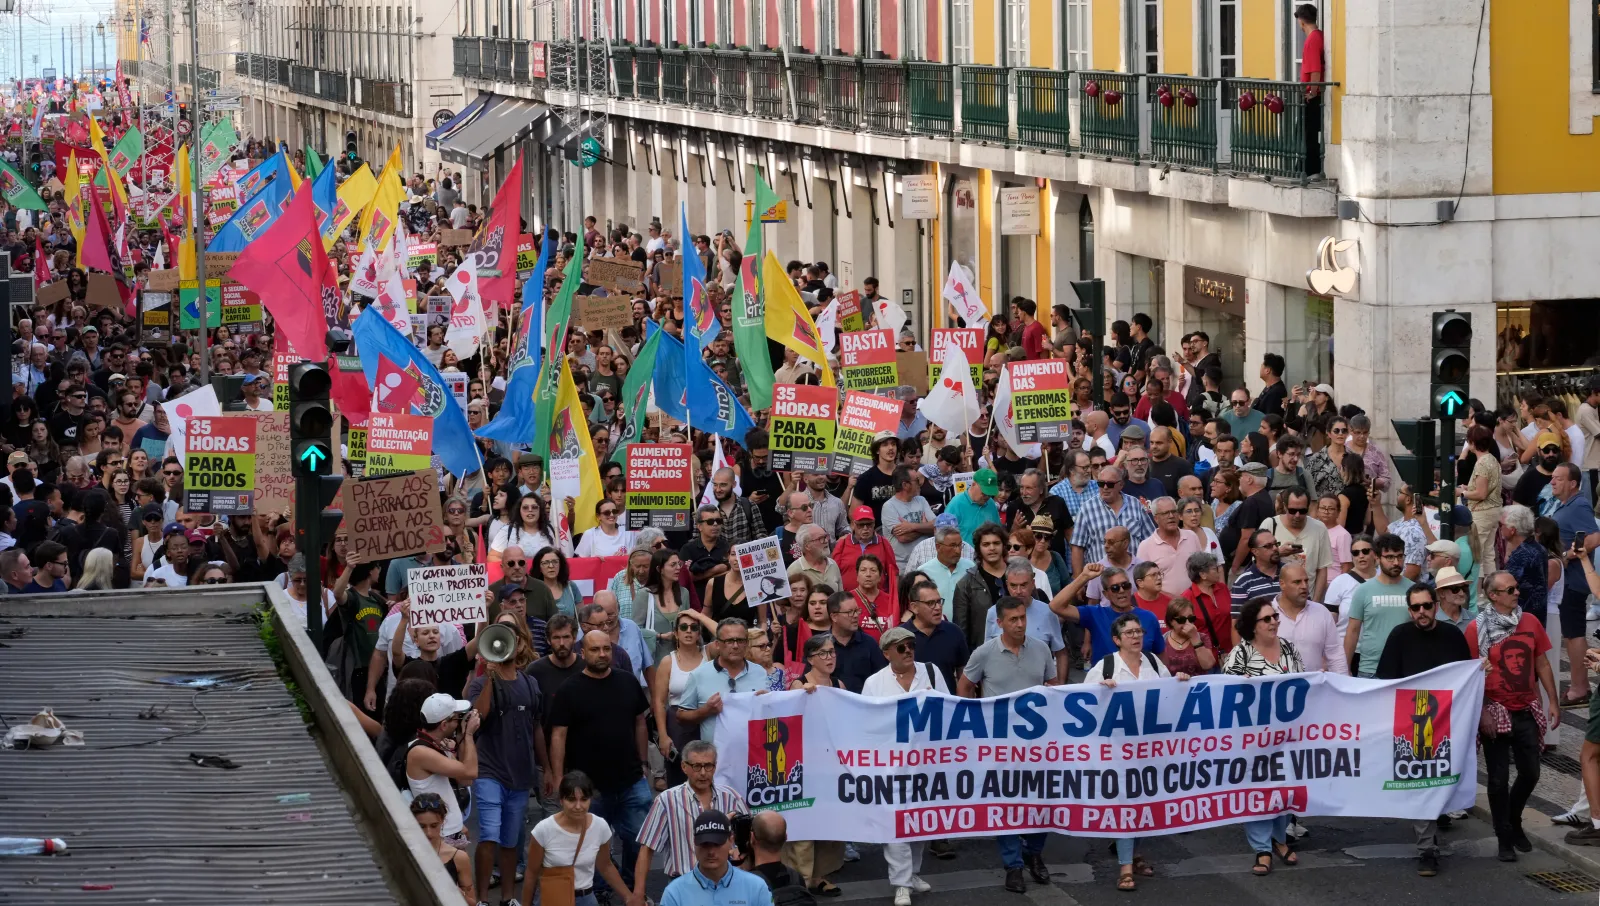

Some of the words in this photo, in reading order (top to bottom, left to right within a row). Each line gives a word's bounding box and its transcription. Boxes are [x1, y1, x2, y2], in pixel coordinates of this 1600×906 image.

[62, 157, 102, 169] JVENS
[212, 187, 234, 200] SMN
[843, 333, 887, 351] BASTA
[934, 331, 977, 349] BASTA
[844, 352, 858, 365] DE
[846, 366, 892, 378] EMPOBRECER
[1012, 362, 1064, 377] AUMENTO
[847, 380, 852, 388] A
[854, 375, 895, 388] TRABALHAR
[1013, 378, 1035, 390] DAS
[777, 387, 796, 400] 35
[1015, 392, 1066, 407] REFORMAS
[775, 402, 830, 418] HORAS
[848, 394, 853, 403] A
[855, 396, 899, 414] SEGURANÇA
[846, 406, 871, 418] SOCIAL
[1017, 409, 1022, 420] E
[1024, 405, 1066, 420] PENSÕES
[191, 420, 212, 434] 35
[373, 417, 386, 427] SIM
[388, 416, 394, 427] À
[774, 420, 817, 435] PARA
[843, 413, 849, 425] É
[850, 418, 876, 430] NOSSA!
[372, 430, 428, 442] CONTRATAÇÃO
[774, 435, 826, 450] TODOS
[840, 428, 858, 442] NÃO
[859, 432, 865, 443] É
[189, 437, 250, 451] HORAS
[371, 439, 412, 450] COLECTIVA
[631, 448, 682, 457] AUMENTO
[189, 457, 236, 472] PARA
[370, 455, 387, 466] NÃO
[388, 456, 394, 466] À
[631, 459, 665, 468] GERAL
[666, 459, 687, 468] DOS
[189, 472, 246, 487] TODOS
[630, 469, 682, 478] SALÁRIOS
[352, 481, 391, 501] PAZ
[401, 475, 432, 493] AOS
[630, 481, 650, 490] 15%
[358, 492, 428, 516] BARRACOS
[629, 494, 664, 506] MÍNIMO
[665, 496, 686, 505] 150€
[354, 514, 398, 532] GUERRA
[406, 511, 433, 527] AOS
[738, 545, 760, 555] SALÁRIO
[761, 540, 777, 549] IGUAL
[410, 571, 420, 580] UM
[422, 568, 456, 580] GOVERNO
[458, 568, 468, 576] QUE
[469, 564, 484, 575] NÃO
[755, 561, 777, 571] TRABALHO
[409, 582, 444, 594] TOLERA
[446, 578, 485, 590] PROTESTO
[417, 592, 434, 605] NÃO
[438, 593, 474, 602] TOLERA
[411, 606, 484, 626] DEMOCRACIA
[896, 692, 1048, 743] MAIS
[1062, 678, 1310, 737] SALÁRIO
[837, 745, 967, 766] MELHORES
[978, 741, 1090, 762] PENSÕES
[1101, 744, 1112, 761] E
[1122, 735, 1232, 760] SERVIÇOS
[1242, 723, 1361, 750] PÚBLICOS!
[838, 771, 949, 804] CONTRA
[956, 770, 974, 799] O
[981, 769, 1119, 800] AUMENTO
[1126, 765, 1158, 799] DO
[1164, 757, 1247, 792] CUSTO
[1252, 751, 1285, 783] DE
[1290, 748, 1361, 780] VIDA!
[1395, 759, 1450, 779] CGTP
[1429, 777, 1456, 786] NACIONAL
[748, 783, 802, 806] CGTP
[781, 801, 810, 809] NACIONAL
[904, 807, 975, 834] NOVO
[987, 806, 1070, 827] RUMO
[1082, 807, 1155, 829] PARA
[1165, 789, 1300, 825] PORTUGAL
[696, 821, 725, 833] POLÍCIA
